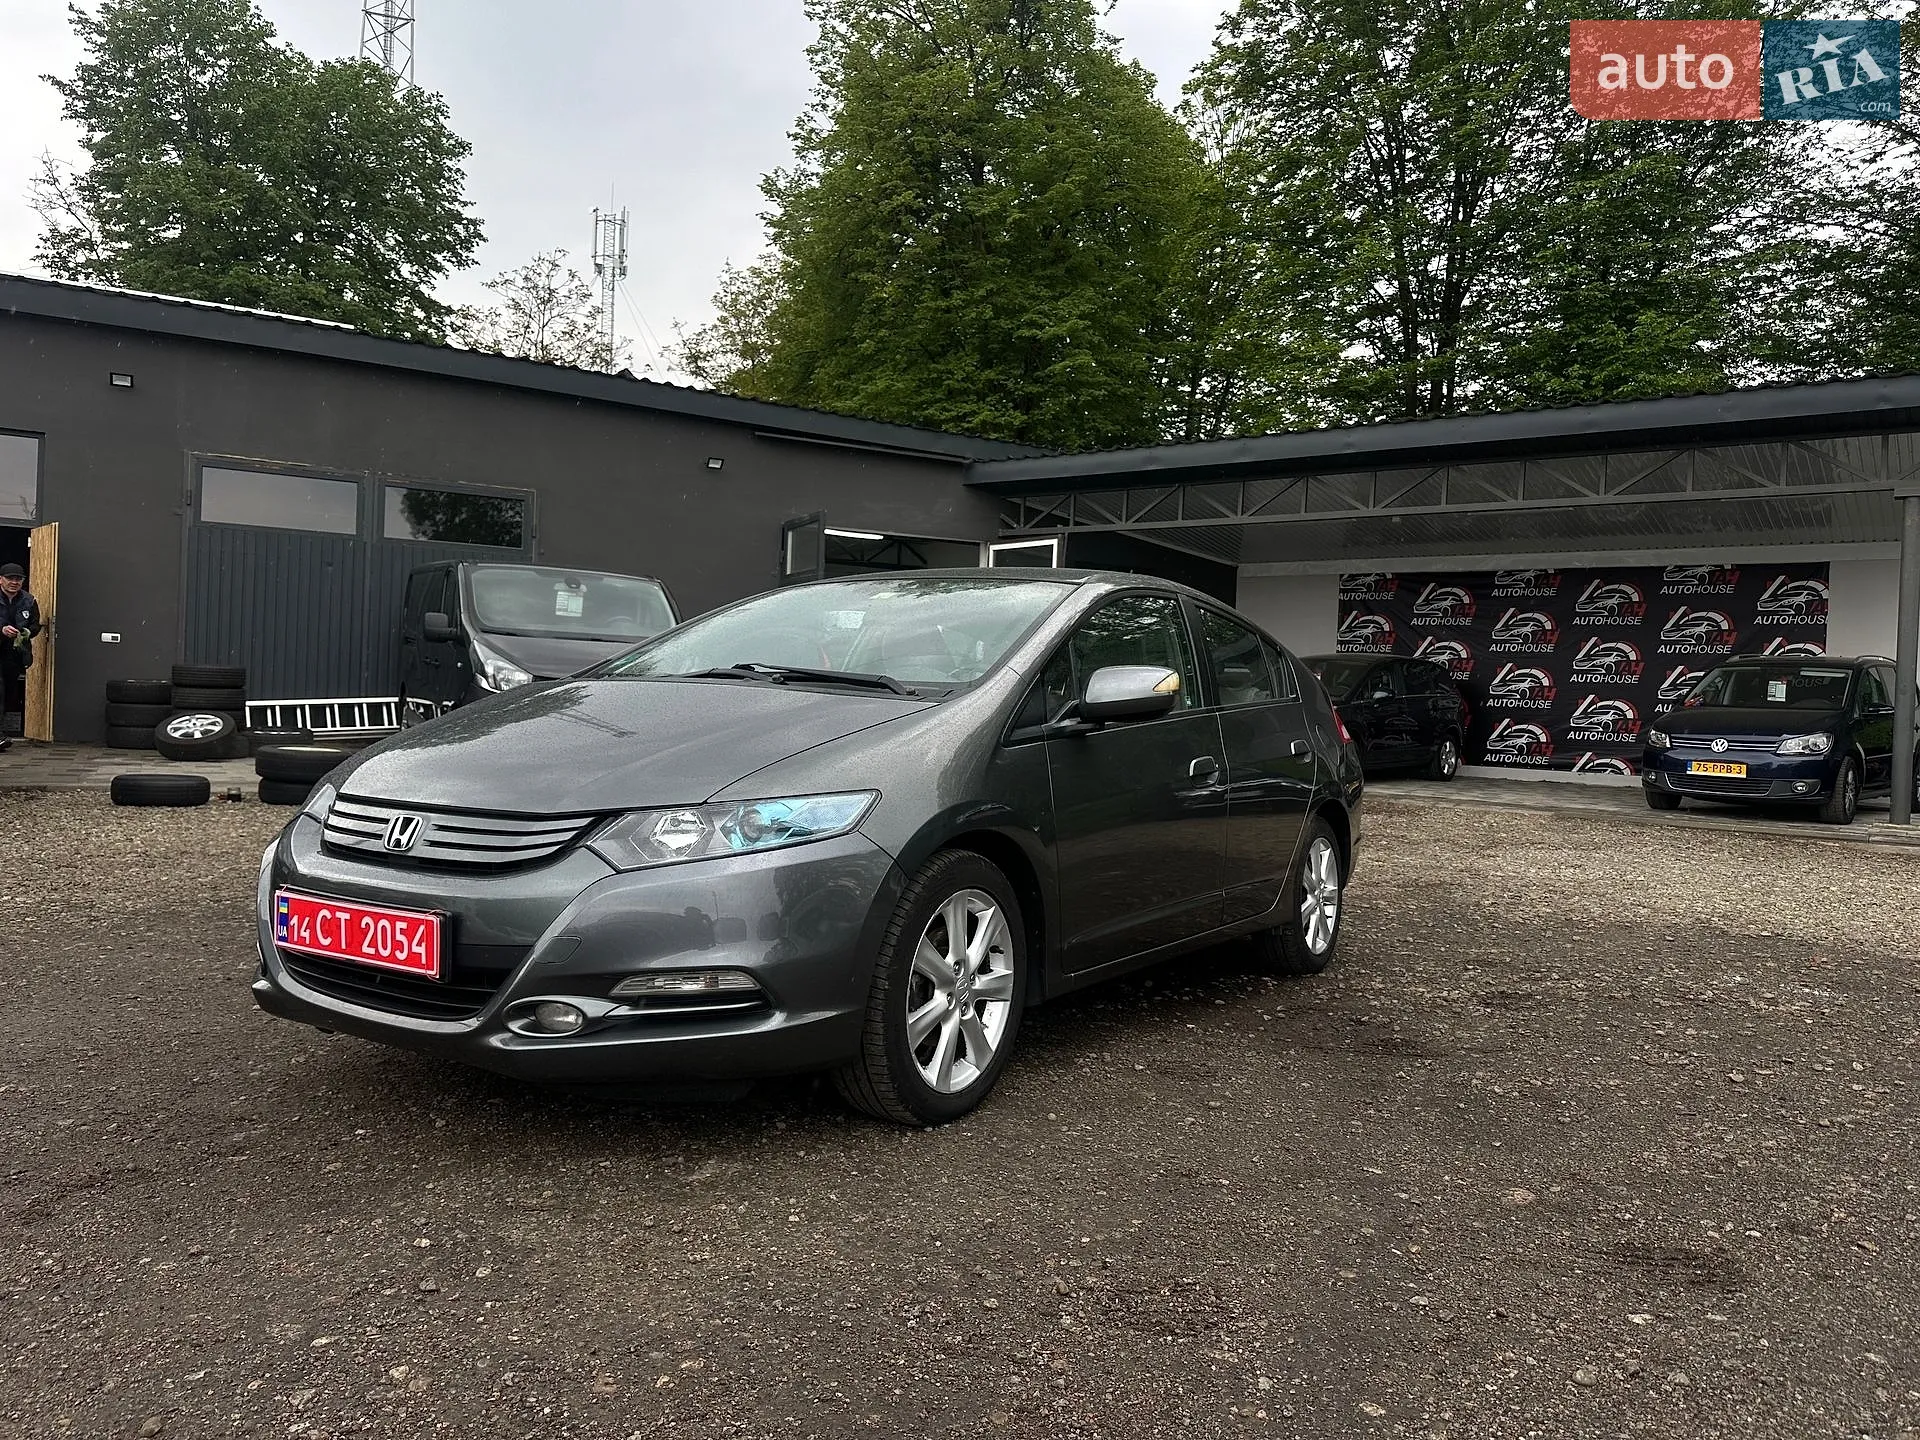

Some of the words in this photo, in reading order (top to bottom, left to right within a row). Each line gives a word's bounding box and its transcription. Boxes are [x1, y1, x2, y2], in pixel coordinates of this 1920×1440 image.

[1491, 588, 1557, 597] AUTOHOUSE
[1660, 584, 1735, 594] AUTOHOUSE
[1339, 592, 1395, 600] AUTOHOUSE
[1410, 617, 1472, 626] AUTOHOUSE
[1572, 616, 1642, 625] AUTOHOUSE
[1489, 643, 1555, 653] AUTOHOUSE
[1657, 644, 1732, 654] AUTOHOUSE
[1570, 674, 1640, 684] AUTOHOUSE
[1486, 699, 1553, 709] AUTOHOUSE
[1567, 731, 1637, 743] AUTOHOUSE
[1483, 754, 1550, 764] AUTOHOUSE
[1696, 763, 1742, 774] 75-PPB-3
[278, 925, 288, 938] UA
[289, 914, 311, 945] 14
[360, 915, 427, 965] 2054
